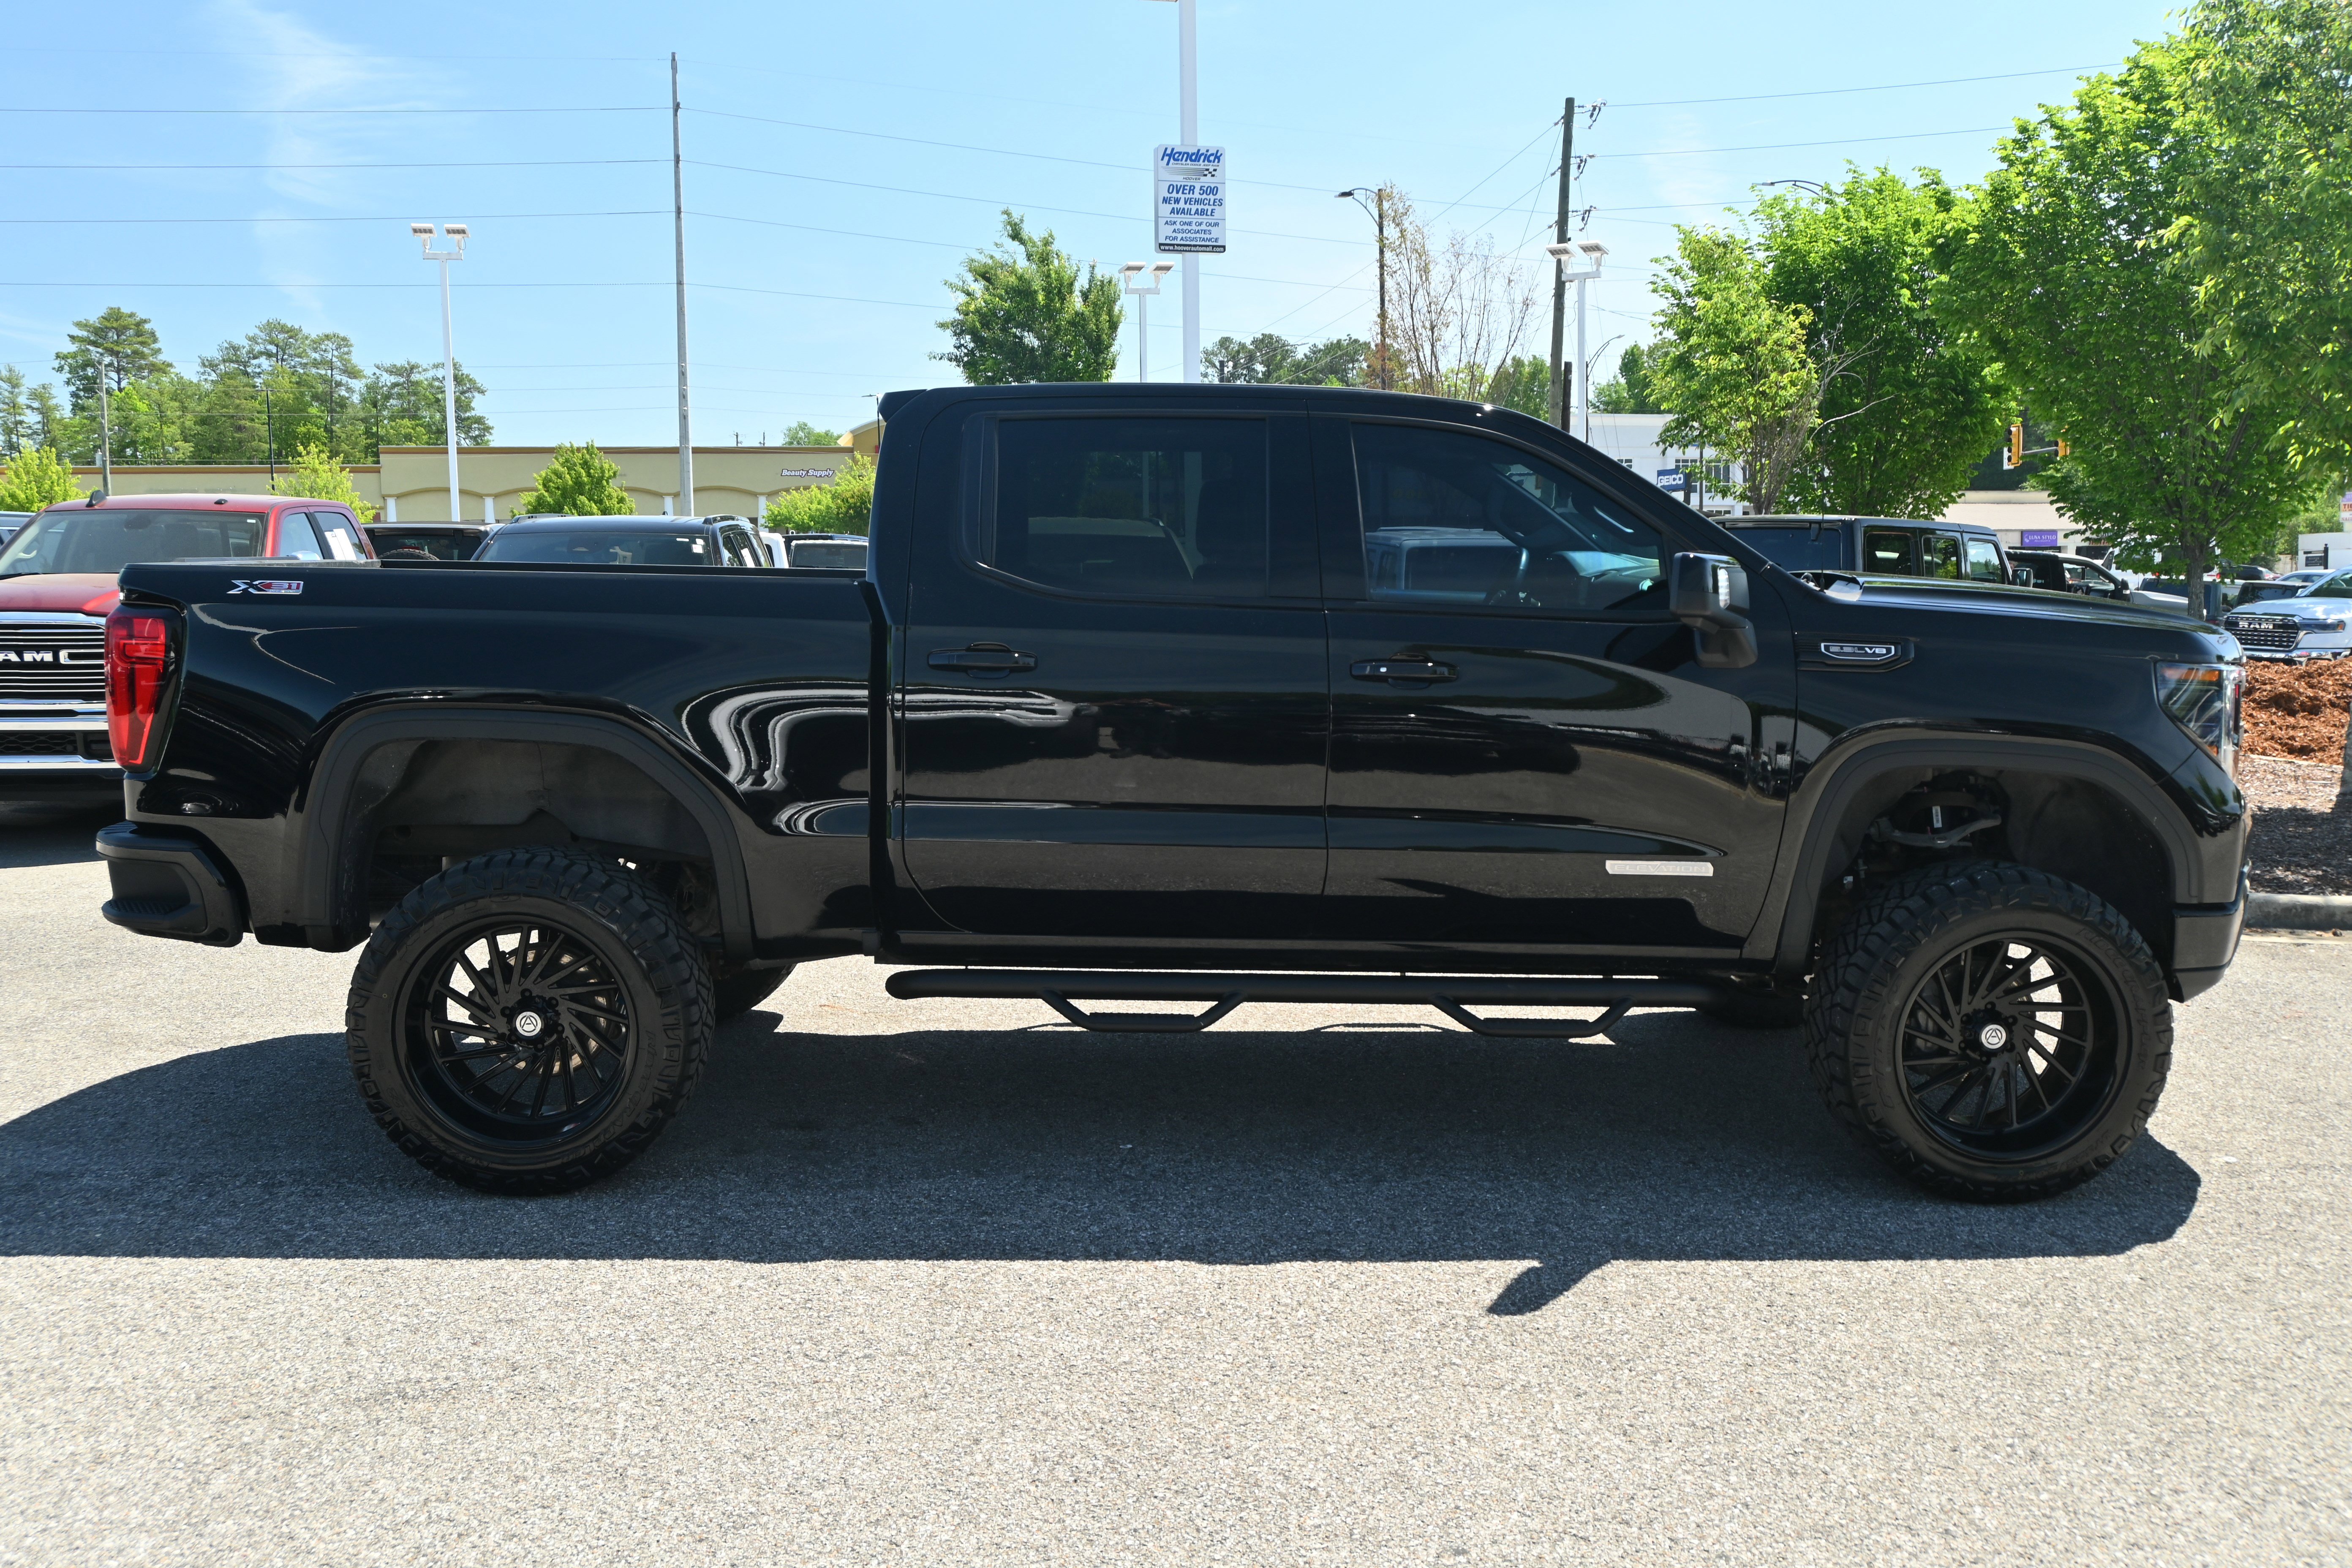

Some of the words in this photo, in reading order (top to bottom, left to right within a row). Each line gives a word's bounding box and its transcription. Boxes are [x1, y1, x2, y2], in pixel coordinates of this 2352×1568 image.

[1161, 147, 1222, 166] Hendrick
[1167, 184, 1195, 195] OVER
[1198, 185, 1218, 196] 500
[1162, 196, 1181, 204] NEW
[1184, 197, 1223, 207] VEHICLES
[1169, 207, 1216, 216] AVAILABLE
[781, 469, 807, 478] Beauty
[807, 468, 834, 478] Supply
[1658, 474, 1683, 486] GEICO
[0, 651, 53, 662] AM
